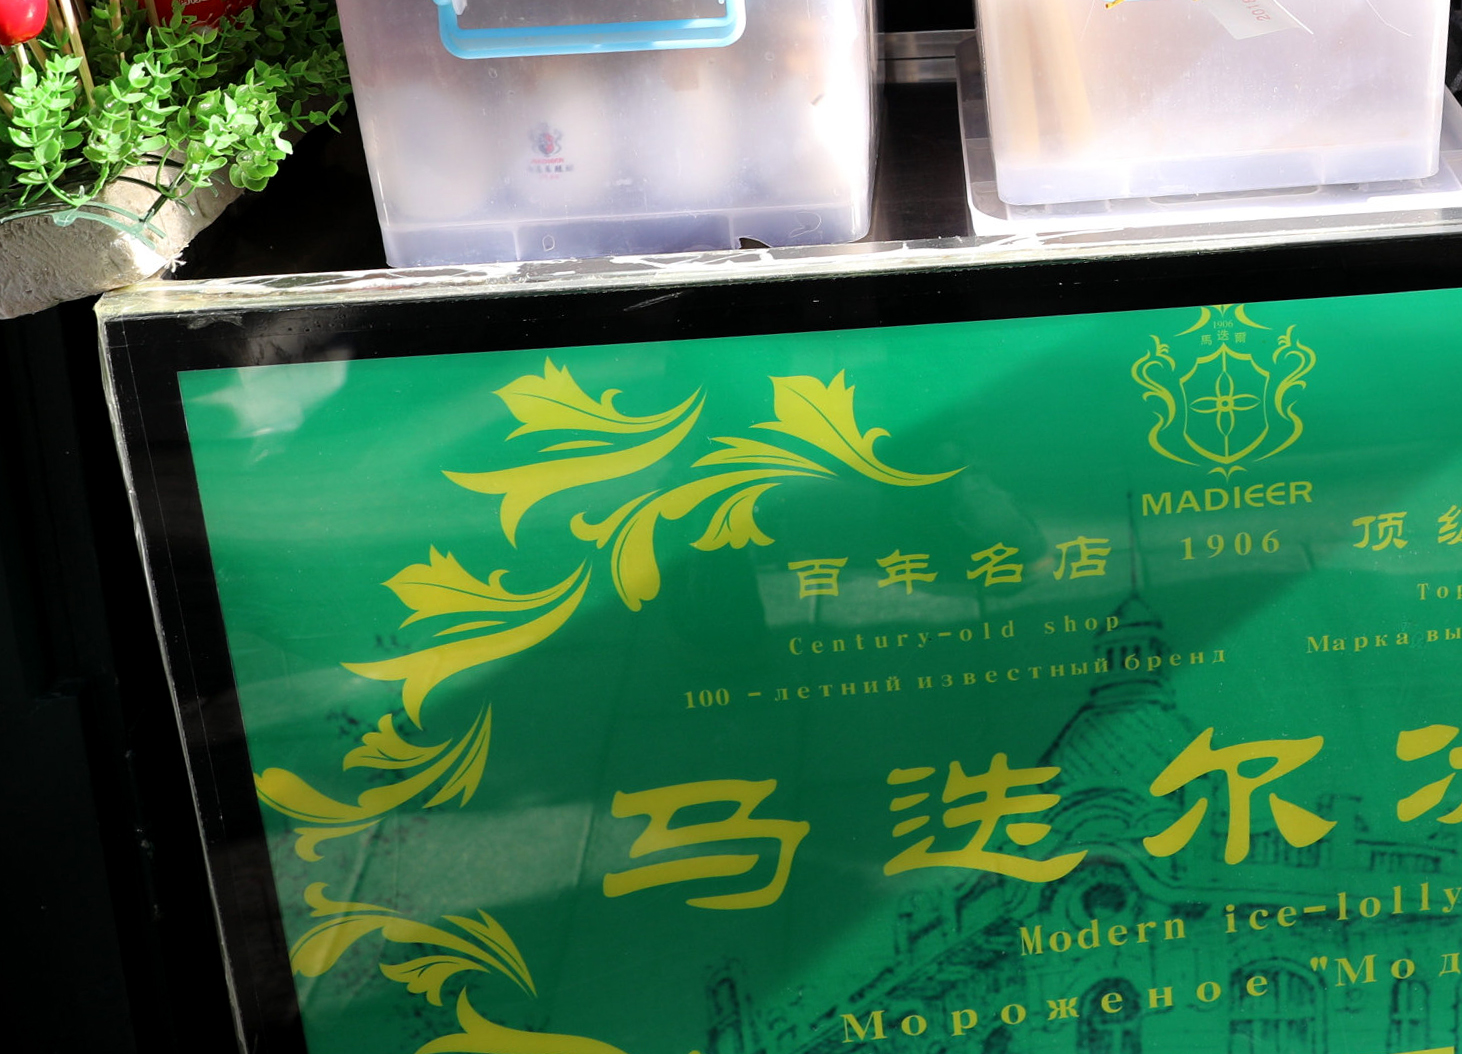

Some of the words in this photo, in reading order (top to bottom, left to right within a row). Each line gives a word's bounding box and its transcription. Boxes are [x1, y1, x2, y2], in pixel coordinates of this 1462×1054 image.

[1212, 319, 1234, 329] 1906
[1141, 481, 1313, 516] MADIEER
[1180, 529, 1281, 561] 1906
[787, 535, 1112, 600] 百年名店
[788, 618, 1017, 657] Century-old
[1043, 613, 1121, 636] shop
[1306, 630, 1410, 654] Марка
[917, 655, 1110, 691] известный
[1123, 648, 1227, 673] бренд
[1019, 916, 1187, 957] Modern
[841, 973, 1270, 1044] Мороженое
